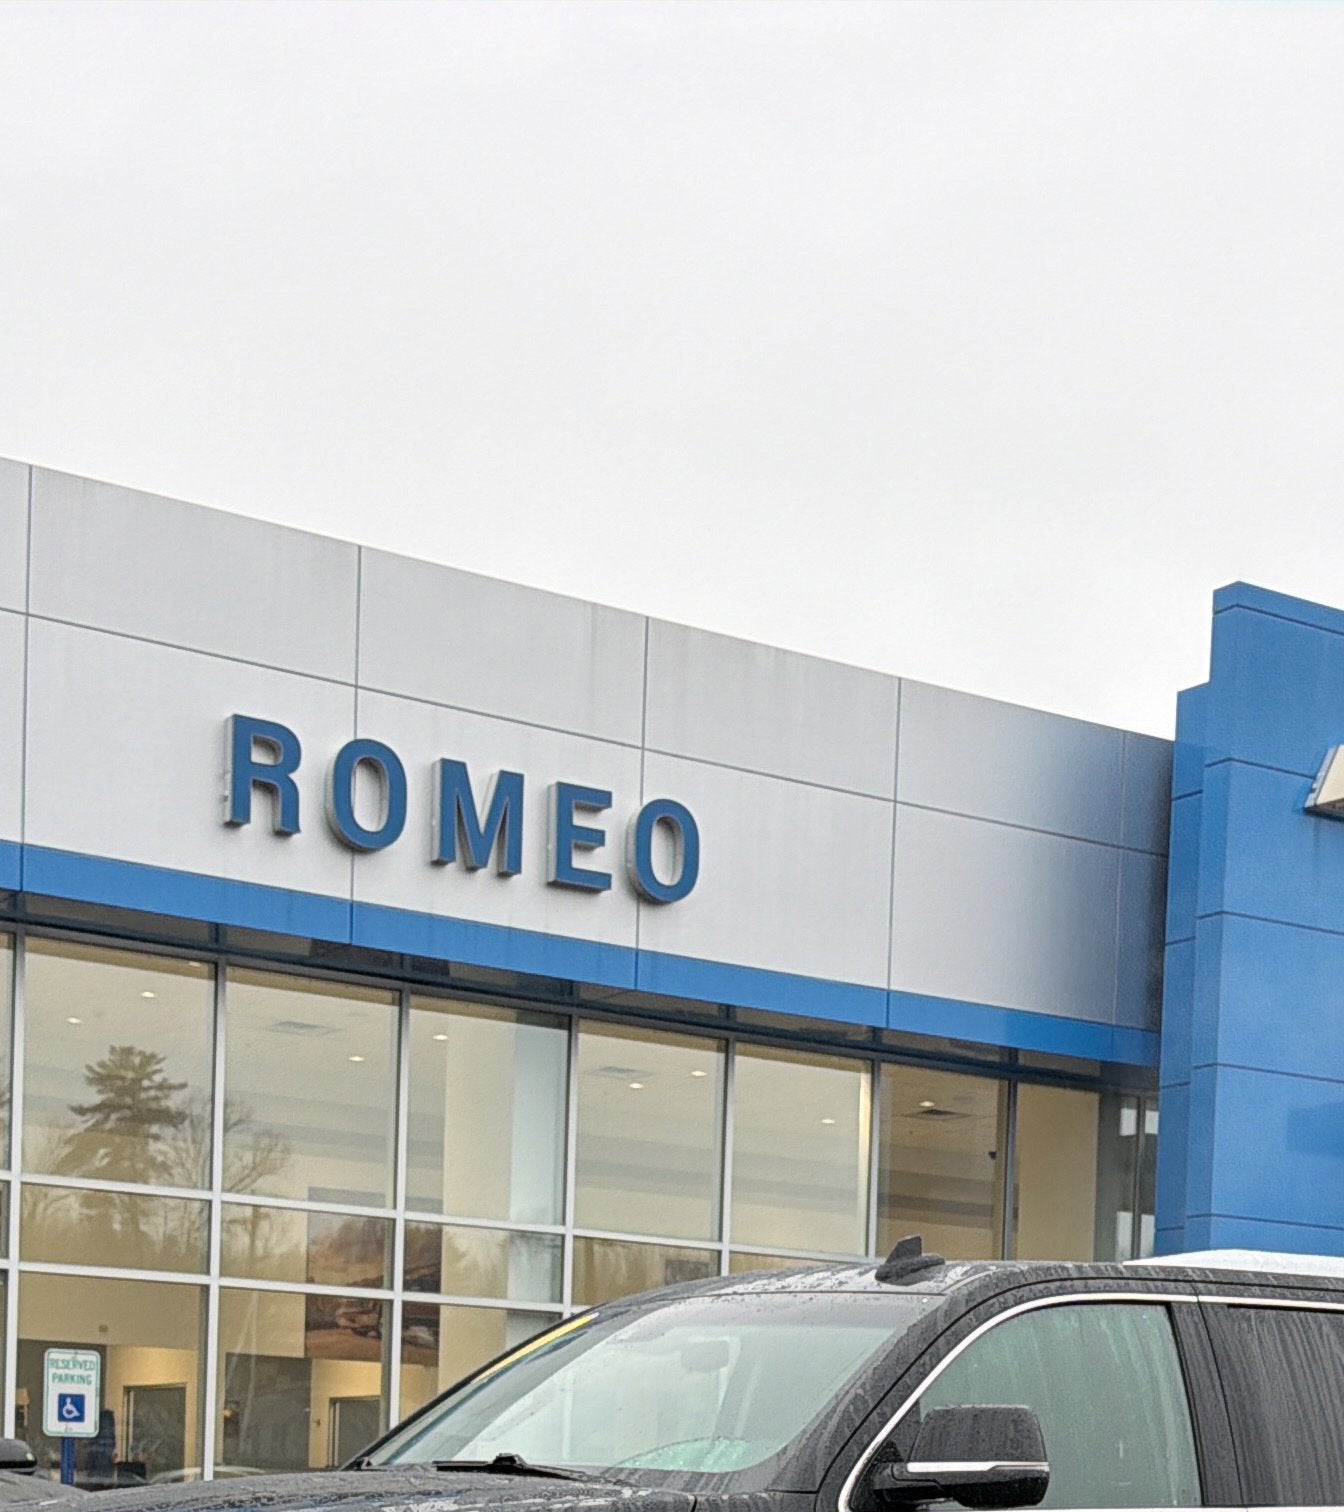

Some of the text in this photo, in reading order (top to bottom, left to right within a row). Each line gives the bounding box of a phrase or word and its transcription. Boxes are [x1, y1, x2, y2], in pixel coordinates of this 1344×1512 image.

[222, 713, 700, 904] ROMEO
[48, 1358, 96, 1371] RESERVED
[52, 1373, 93, 1385] PARKING
